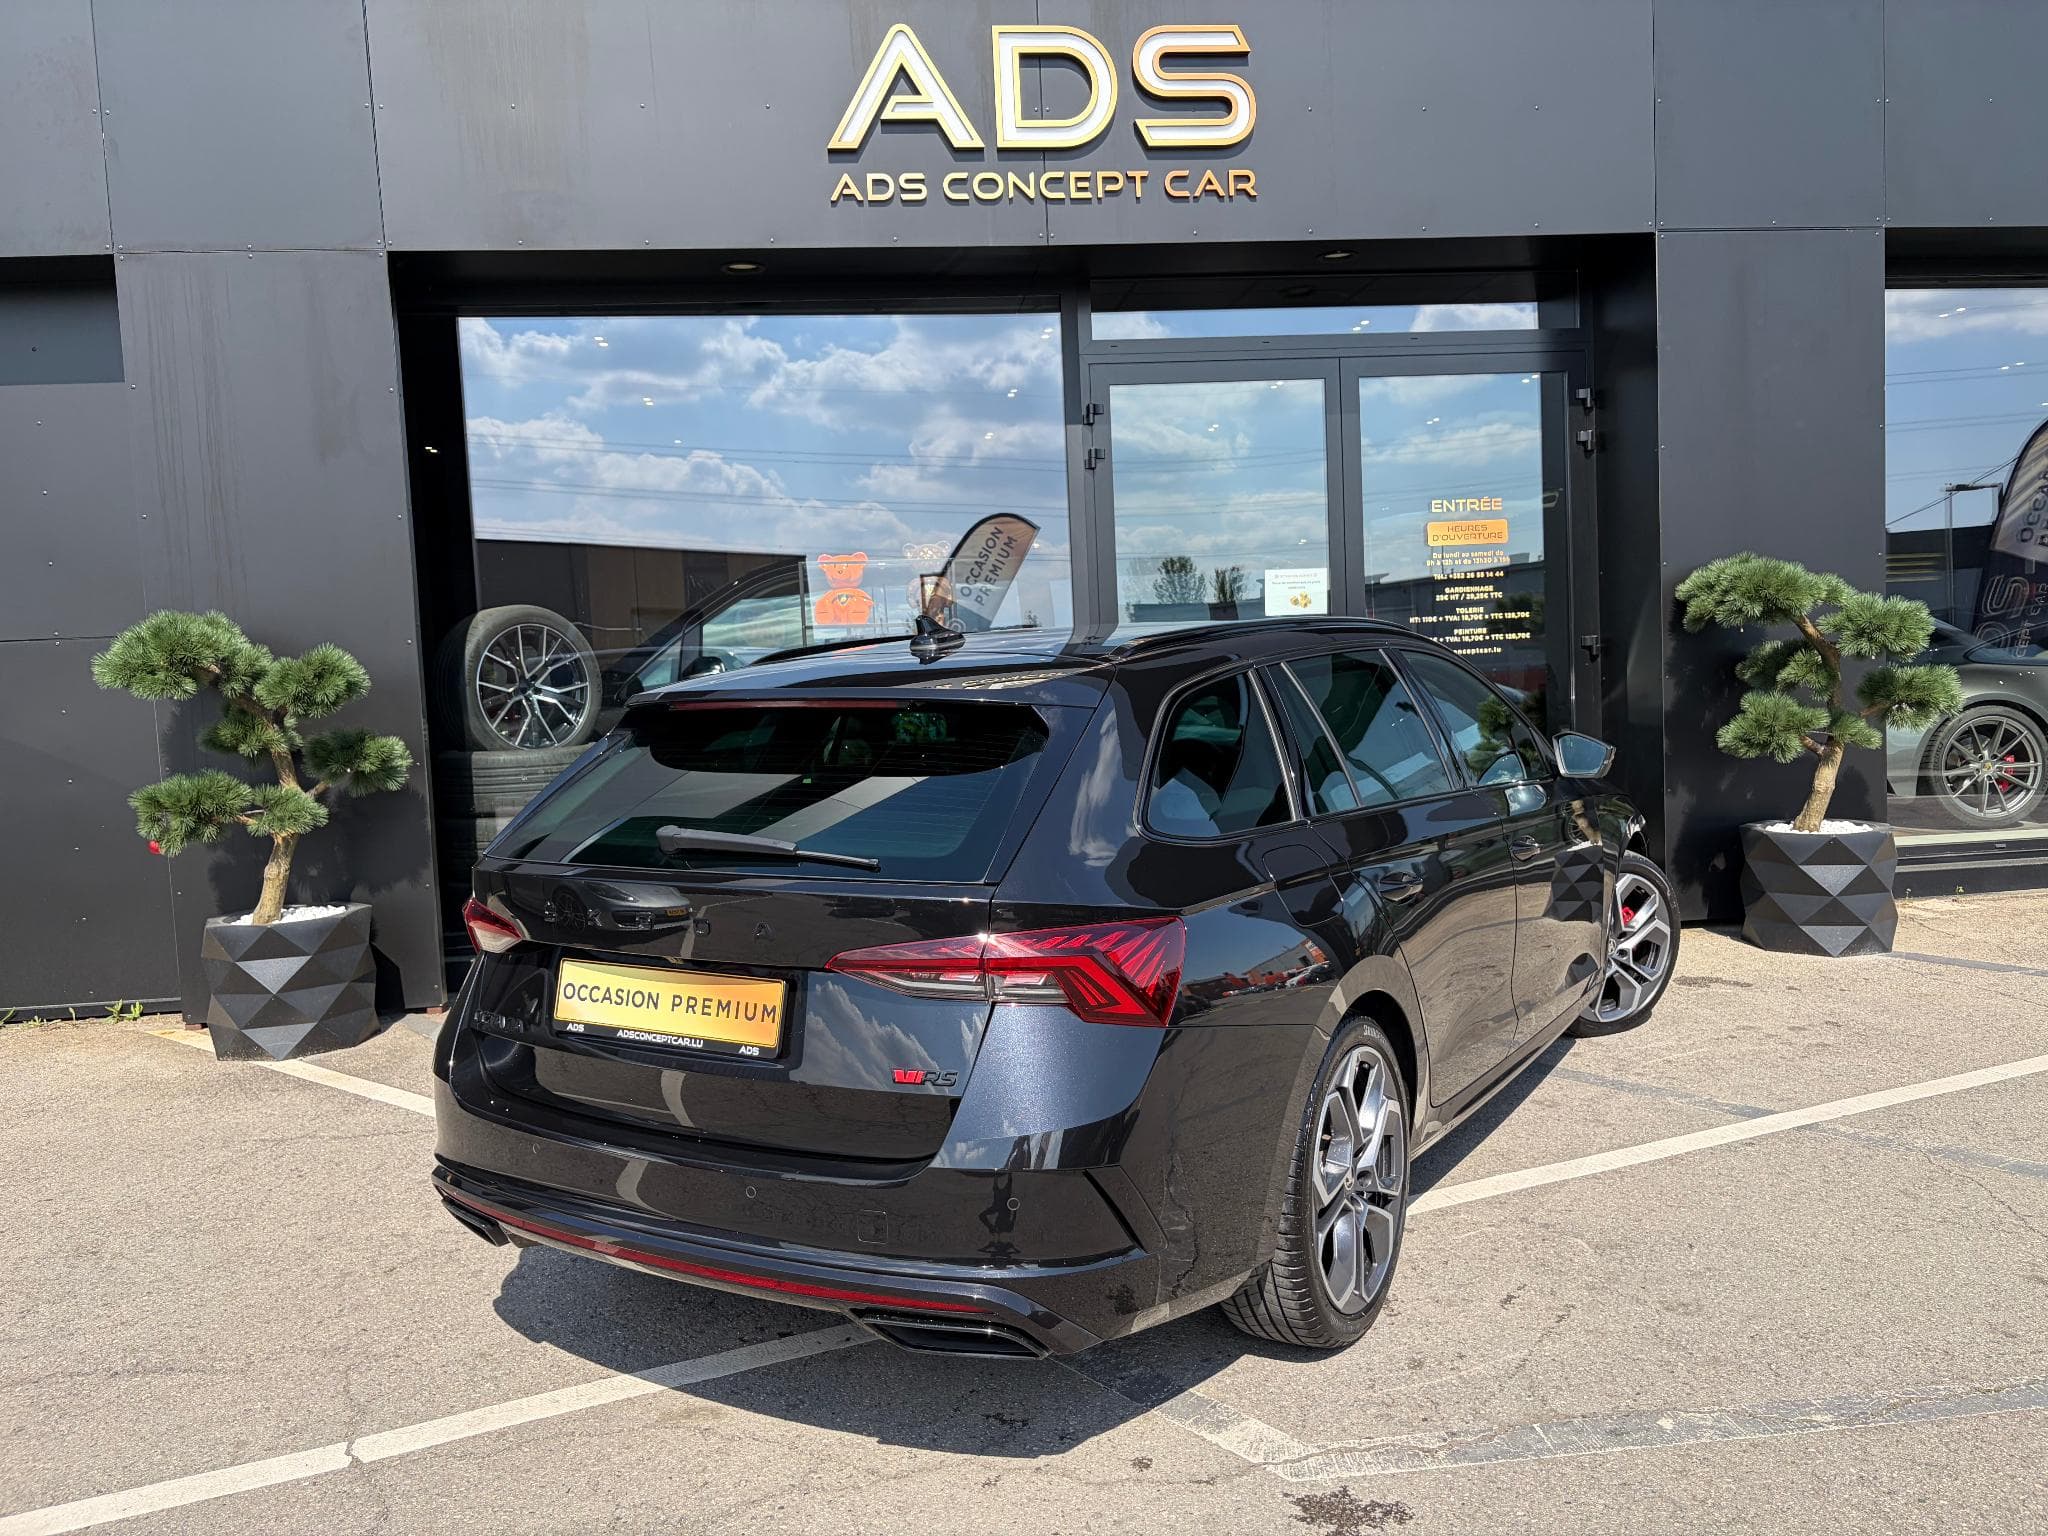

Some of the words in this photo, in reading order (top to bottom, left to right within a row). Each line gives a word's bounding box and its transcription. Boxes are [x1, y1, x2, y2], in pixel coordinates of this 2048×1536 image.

[828, 23, 1257, 150] ADS
[830, 172, 928, 202] ADS
[942, 170, 1150, 201] CONCEPT
[1163, 169, 1258, 198] CAR
[1431, 496, 1503, 513] ENTRÉE
[1432, 531, 1503, 542] D'OUVERTURE
[1447, 524, 1488, 533] HEURES
[960, 526, 1004, 598] OCCASION
[974, 536, 1018, 606] PREMIUM
[1489, 591, 1503, 599] TTC
[1453, 627, 1488, 636] PEINTURE
[1490, 633, 1504, 641] TTC
[563, 982, 660, 1010] OCCASION
[670, 994, 777, 1024] PREMIUM
[566, 1022, 585, 1033] ADS
[616, 1029, 704, 1048] ADSCONCEPTCAR.LU
[738, 1044, 760, 1056] ADS
